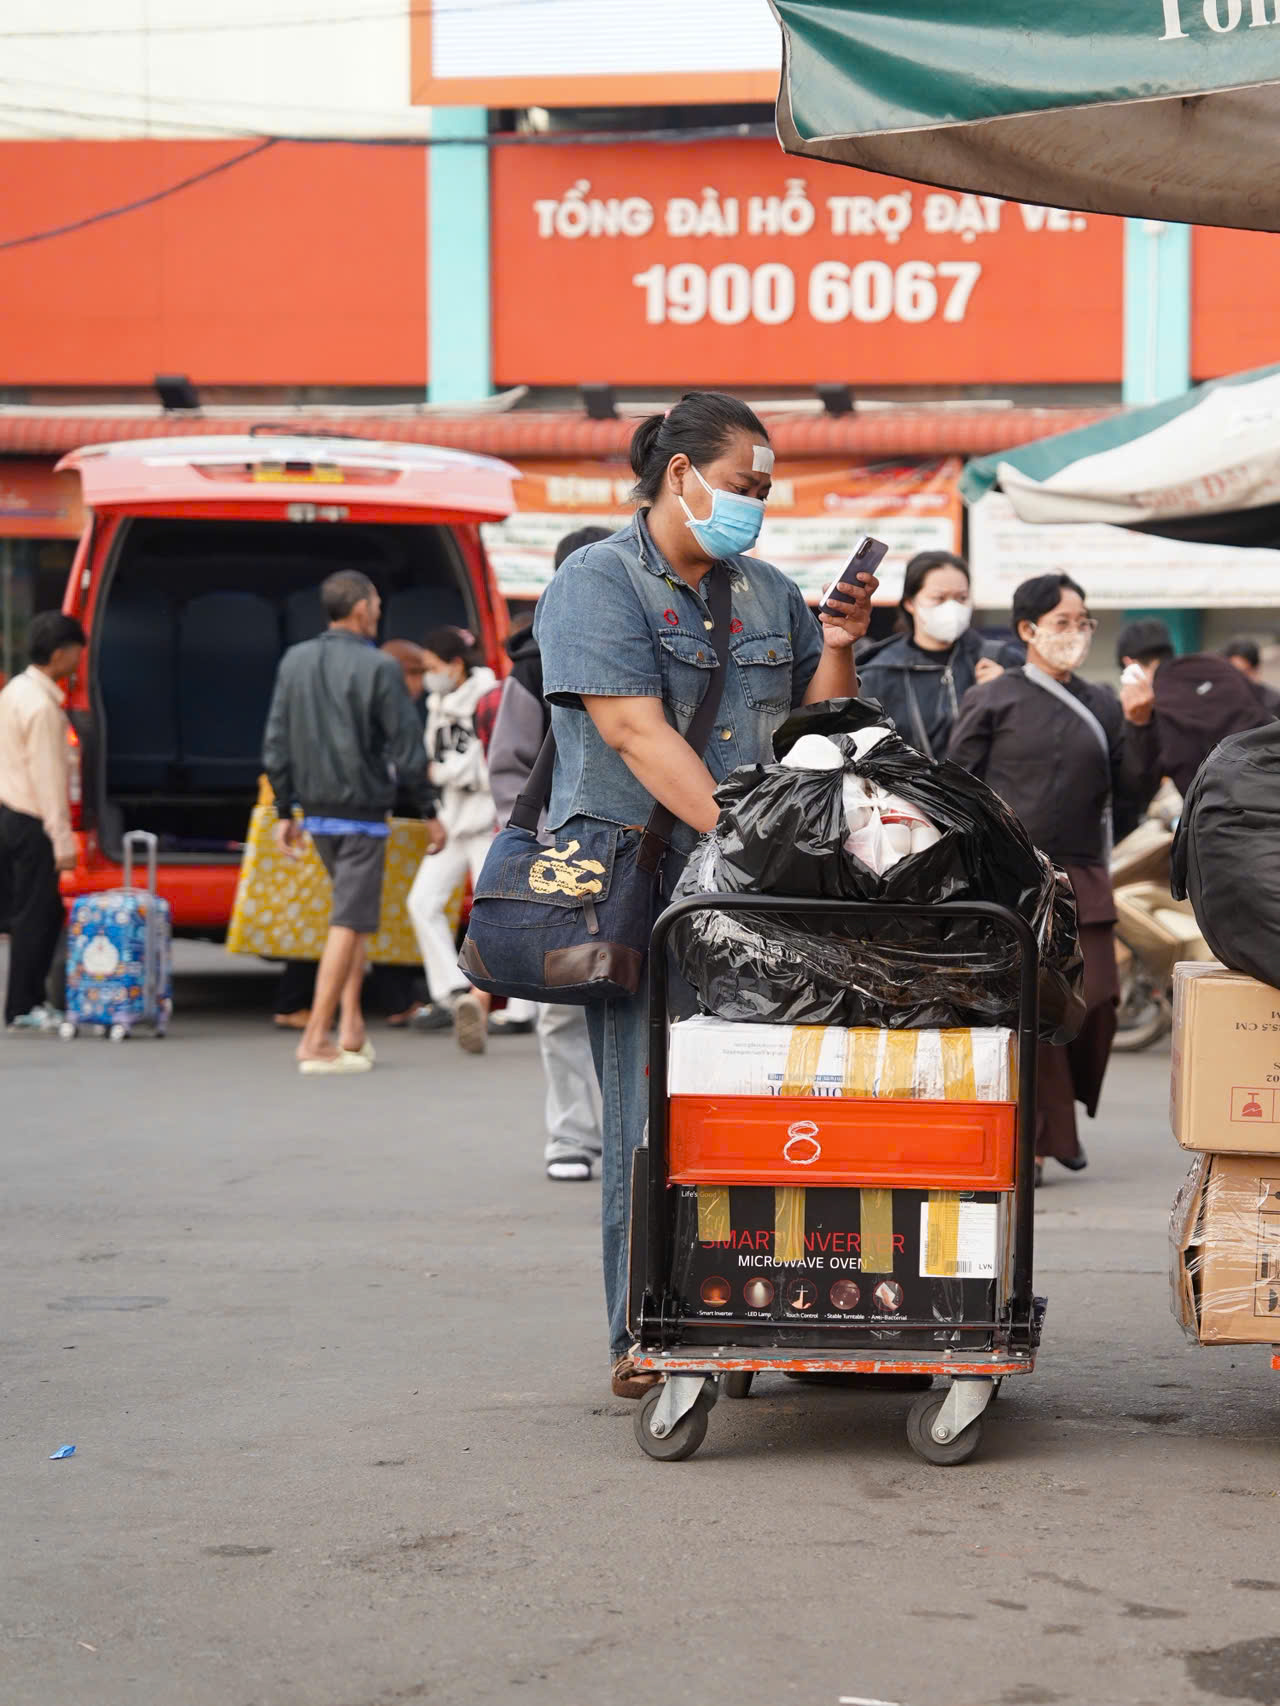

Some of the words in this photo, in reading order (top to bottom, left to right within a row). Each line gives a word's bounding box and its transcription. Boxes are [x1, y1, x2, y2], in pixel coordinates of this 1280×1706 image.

[533, 179, 655, 238] TỔNG
[665, 186, 740, 237] ĐÀI
[748, 178, 815, 237] HỖ
[826, 188, 912, 244] TRỢ
[632, 262, 797, 325] 1900
[808, 260, 983, 323] 6067
[1235, 1022, 1258, 1031] CM
[783, 1120, 821, 1165] 8
[681, 1190, 698, 1198] Life's
[794, 1230, 905, 1254] NVERTER
[738, 1254, 824, 1269] MICROWAVE
[829, 1256, 868, 1270] OVEN
